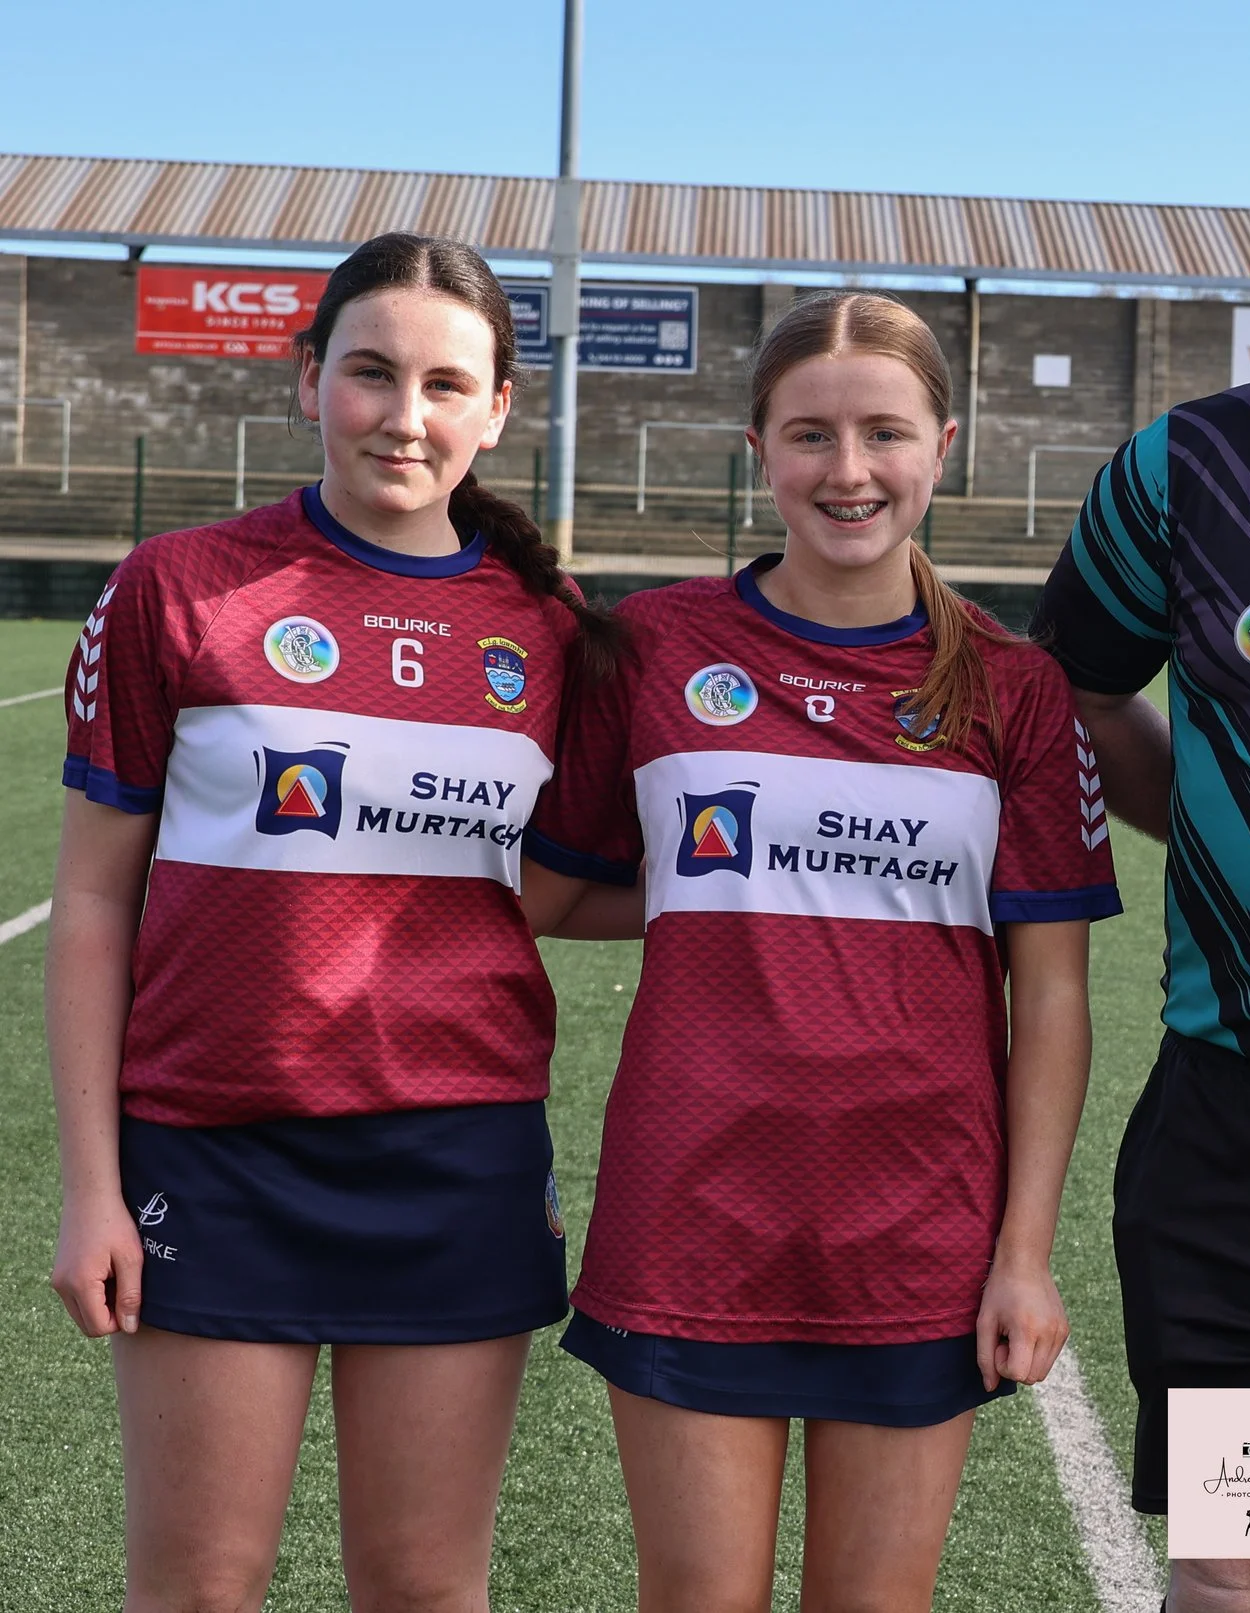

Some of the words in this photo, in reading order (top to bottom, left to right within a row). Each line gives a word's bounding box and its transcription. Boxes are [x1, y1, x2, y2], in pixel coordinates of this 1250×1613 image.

[192, 281, 300, 316] KCS
[579, 296, 610, 310] KING
[363, 614, 452, 638] BOURKE
[391, 638, 425, 688] 6
[779, 673, 866, 694] BOURKE
[410, 771, 516, 810] SHAY
[356, 804, 523, 850] MURTAGH
[817, 810, 929, 848] SHAY
[767, 843, 959, 887] MURTAGH
[143, 1236, 178, 1261] RKE
